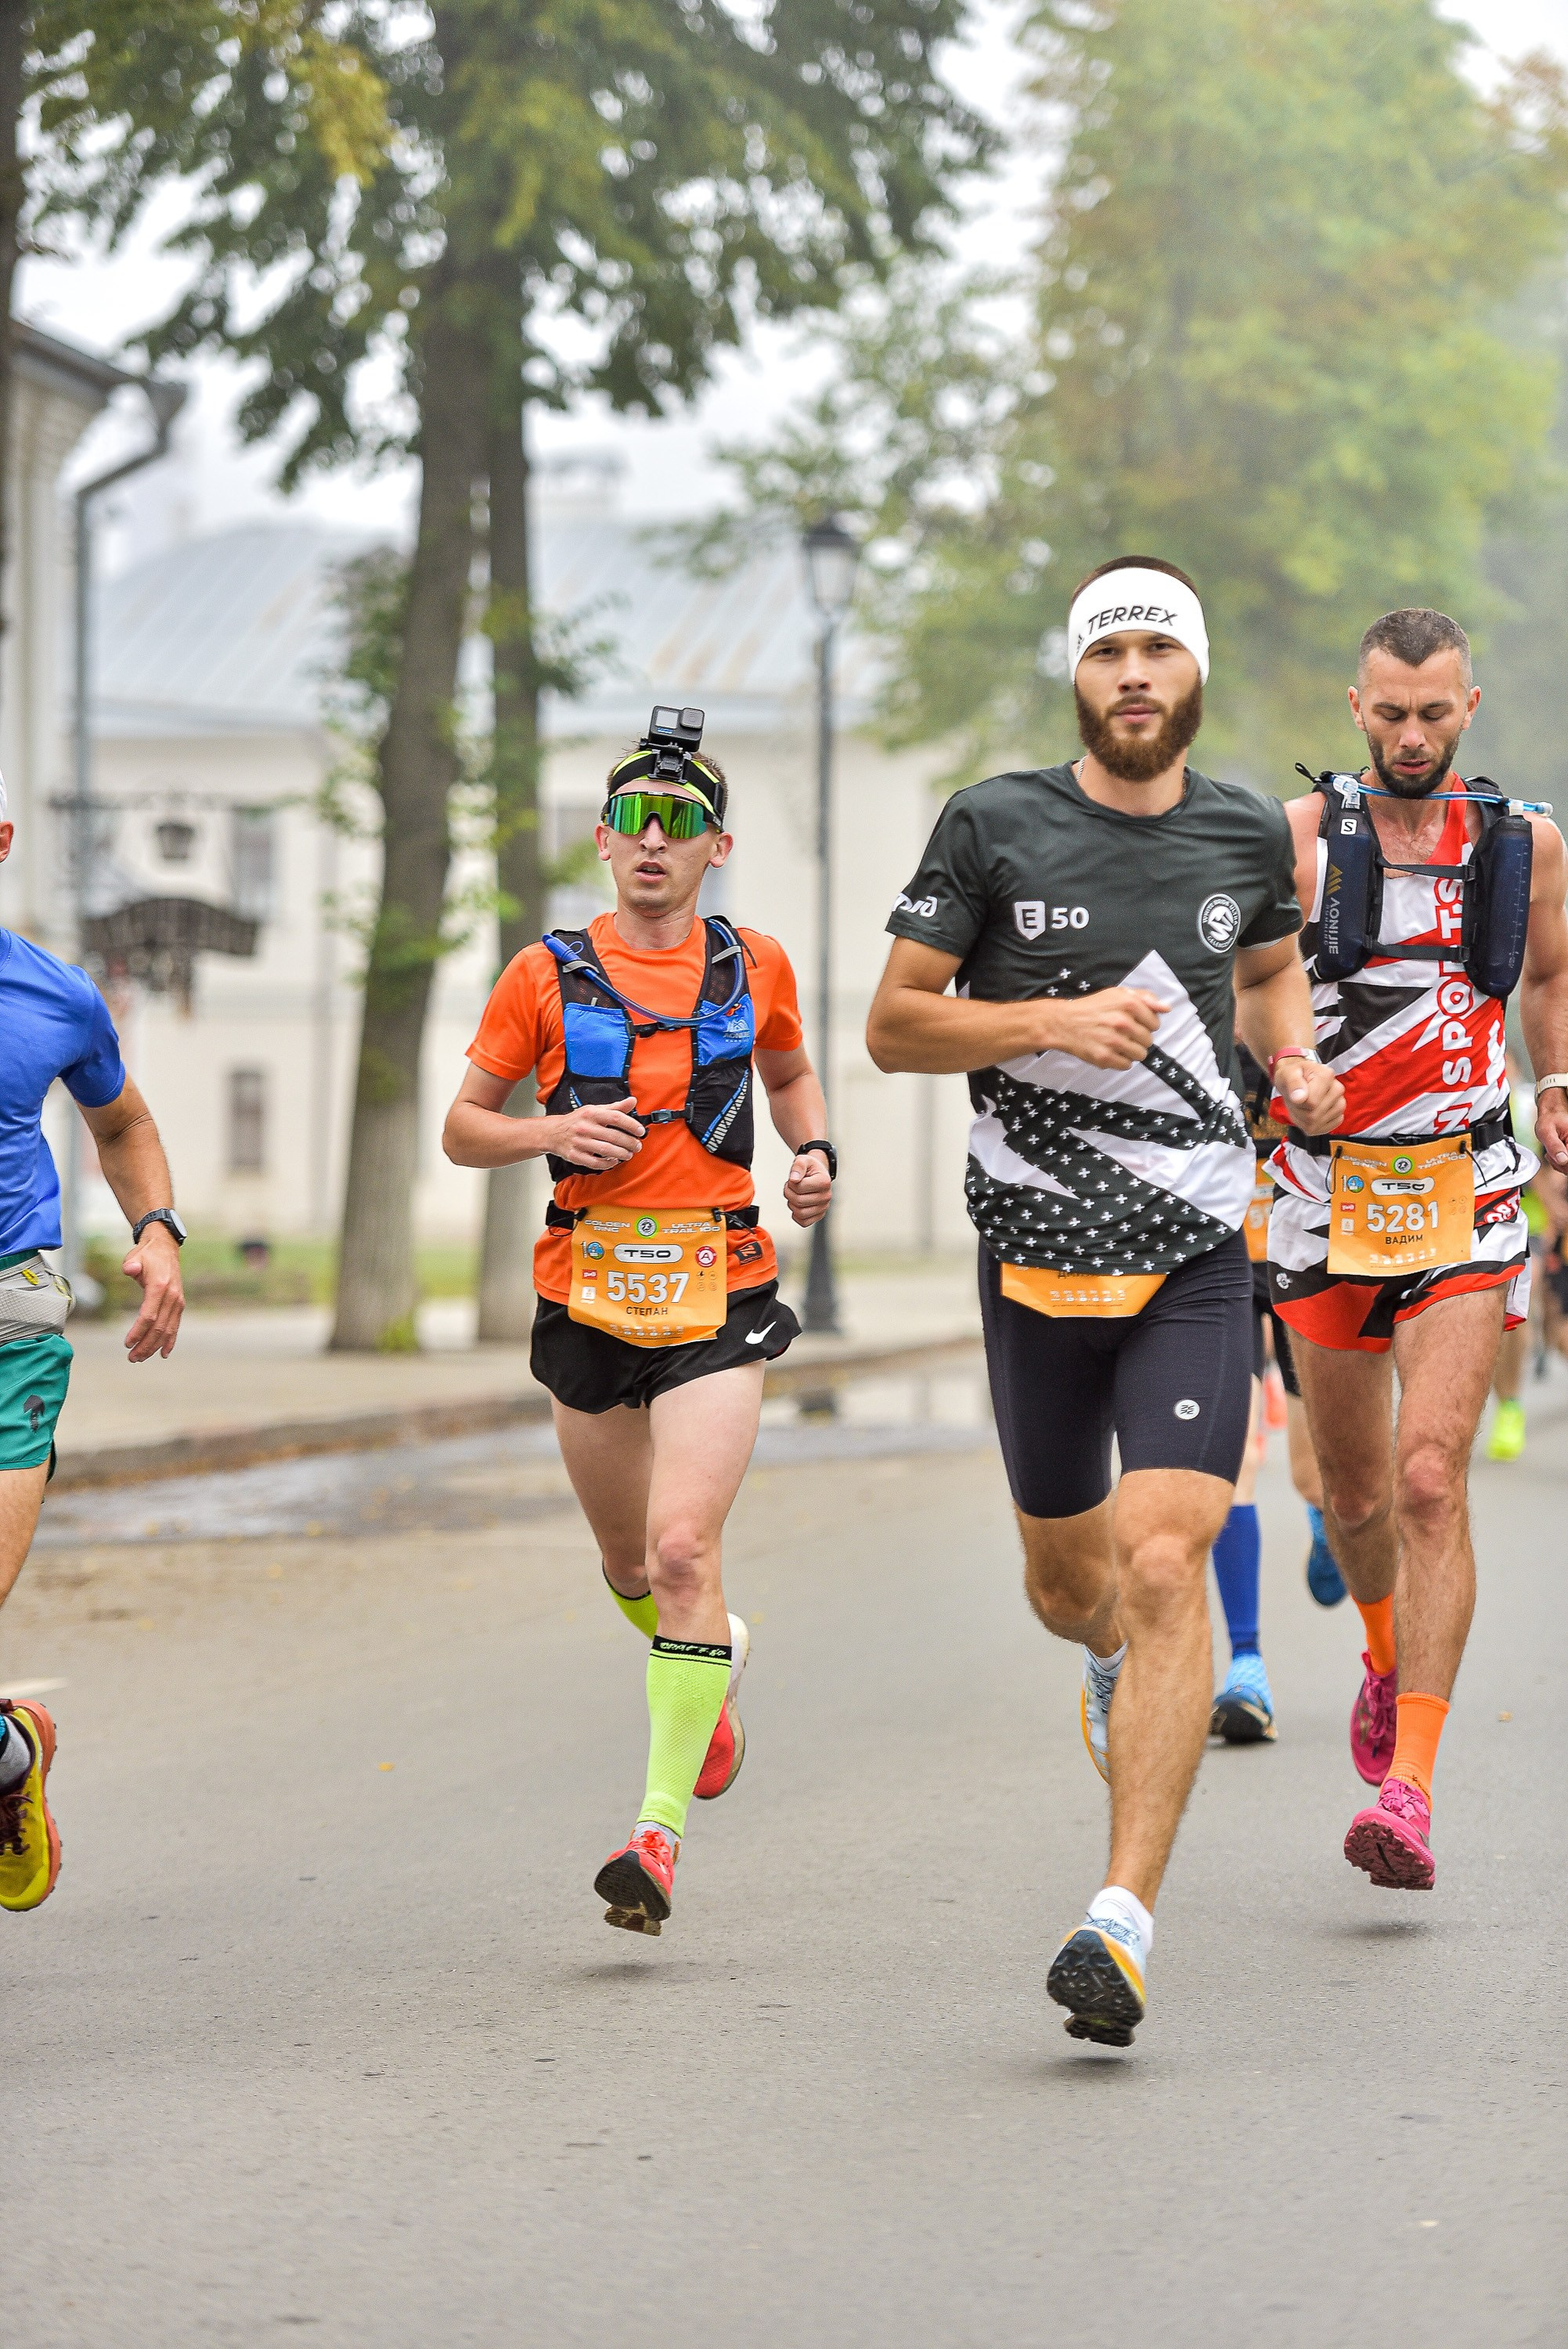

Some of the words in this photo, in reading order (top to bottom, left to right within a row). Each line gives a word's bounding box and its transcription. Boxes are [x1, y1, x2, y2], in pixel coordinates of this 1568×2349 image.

[1087, 604, 1178, 635] TERREX
[1051, 907, 1090, 929] 50
[1435, 872, 1473, 1087] SPOTS
[1382, 1182, 1425, 1191] T50
[1366, 1200, 1439, 1233] 5281
[1385, 1234, 1423, 1245] ВАДИМ
[624, 1249, 672, 1258] T50
[607, 1270, 690, 1304] 5537
[626, 1306, 669, 1316] СТЕПАН
